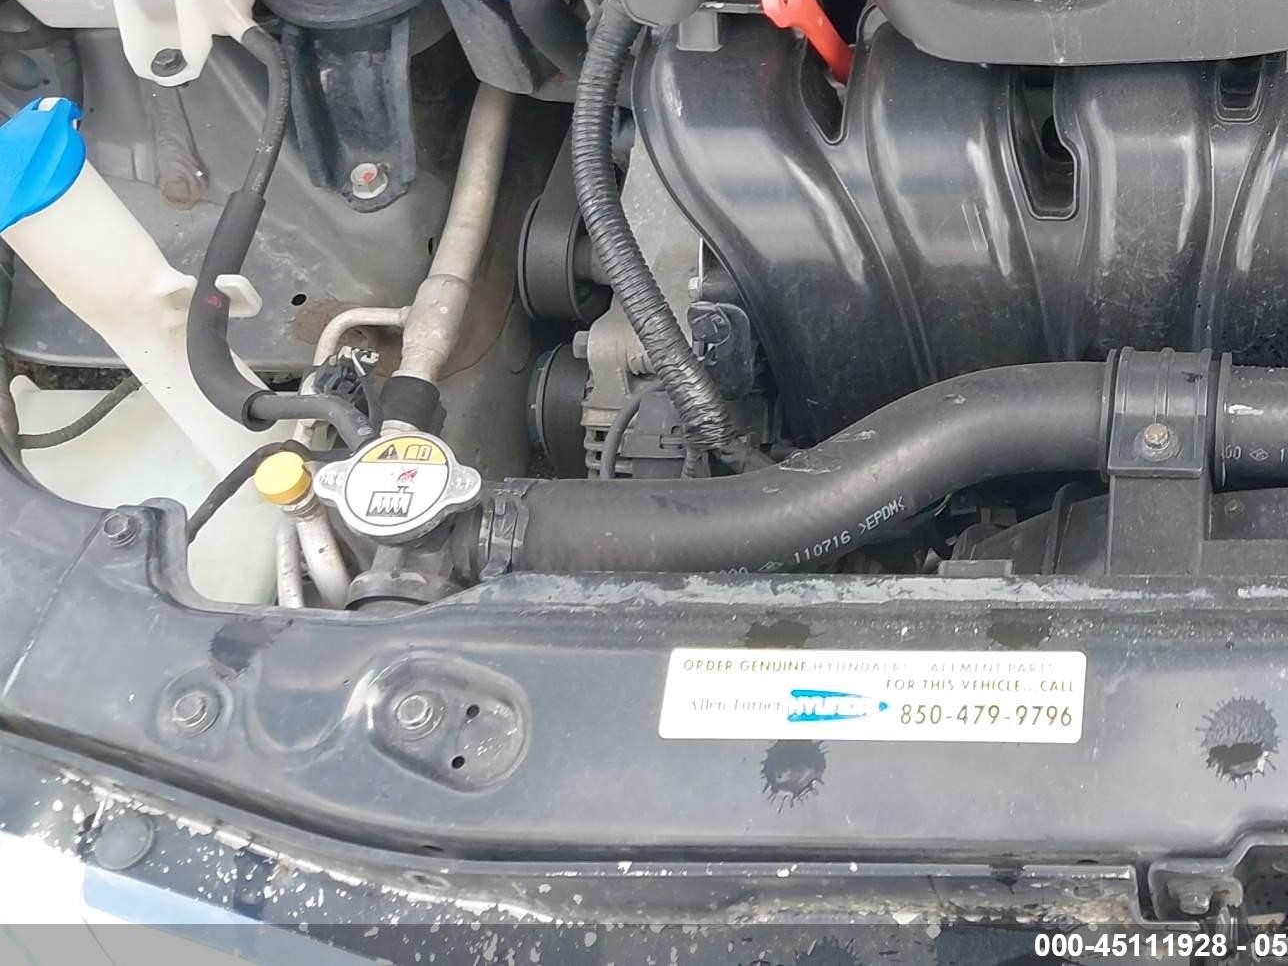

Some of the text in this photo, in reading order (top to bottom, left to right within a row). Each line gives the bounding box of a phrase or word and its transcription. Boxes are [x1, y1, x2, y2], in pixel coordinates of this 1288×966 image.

[793, 530, 852, 564] 110716
[683, 659, 733, 672] ORDER
[739, 659, 807, 672] GENUINE
[886, 679, 915, 691] FOR
[923, 679, 954, 691] THIS
[1040, 680, 1073, 692] CALL
[900, 703, 1073, 727] 850-479-9796
